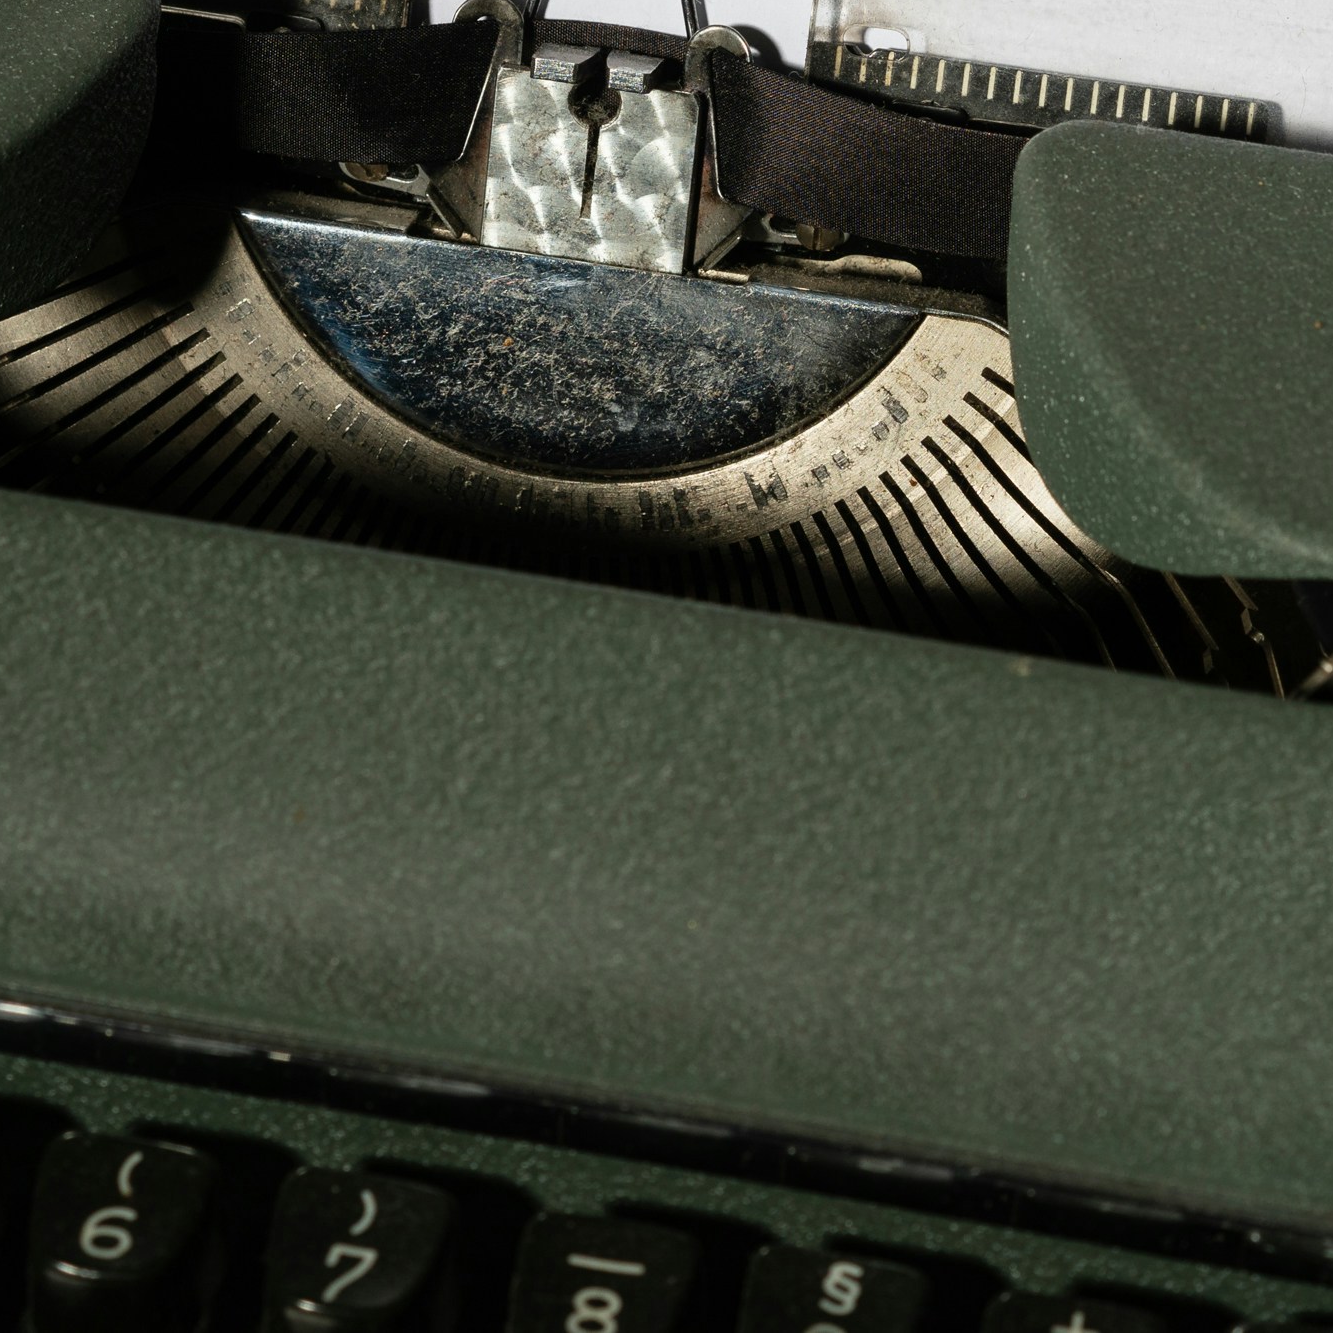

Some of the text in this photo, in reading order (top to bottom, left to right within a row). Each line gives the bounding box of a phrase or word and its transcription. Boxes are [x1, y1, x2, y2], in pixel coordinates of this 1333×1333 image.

[79, 1206, 137, 1260] 6
[322, 1243, 378, 1302] 7
[820, 1261, 864, 1316] §
[565, 1286, 623, 1333] 8
